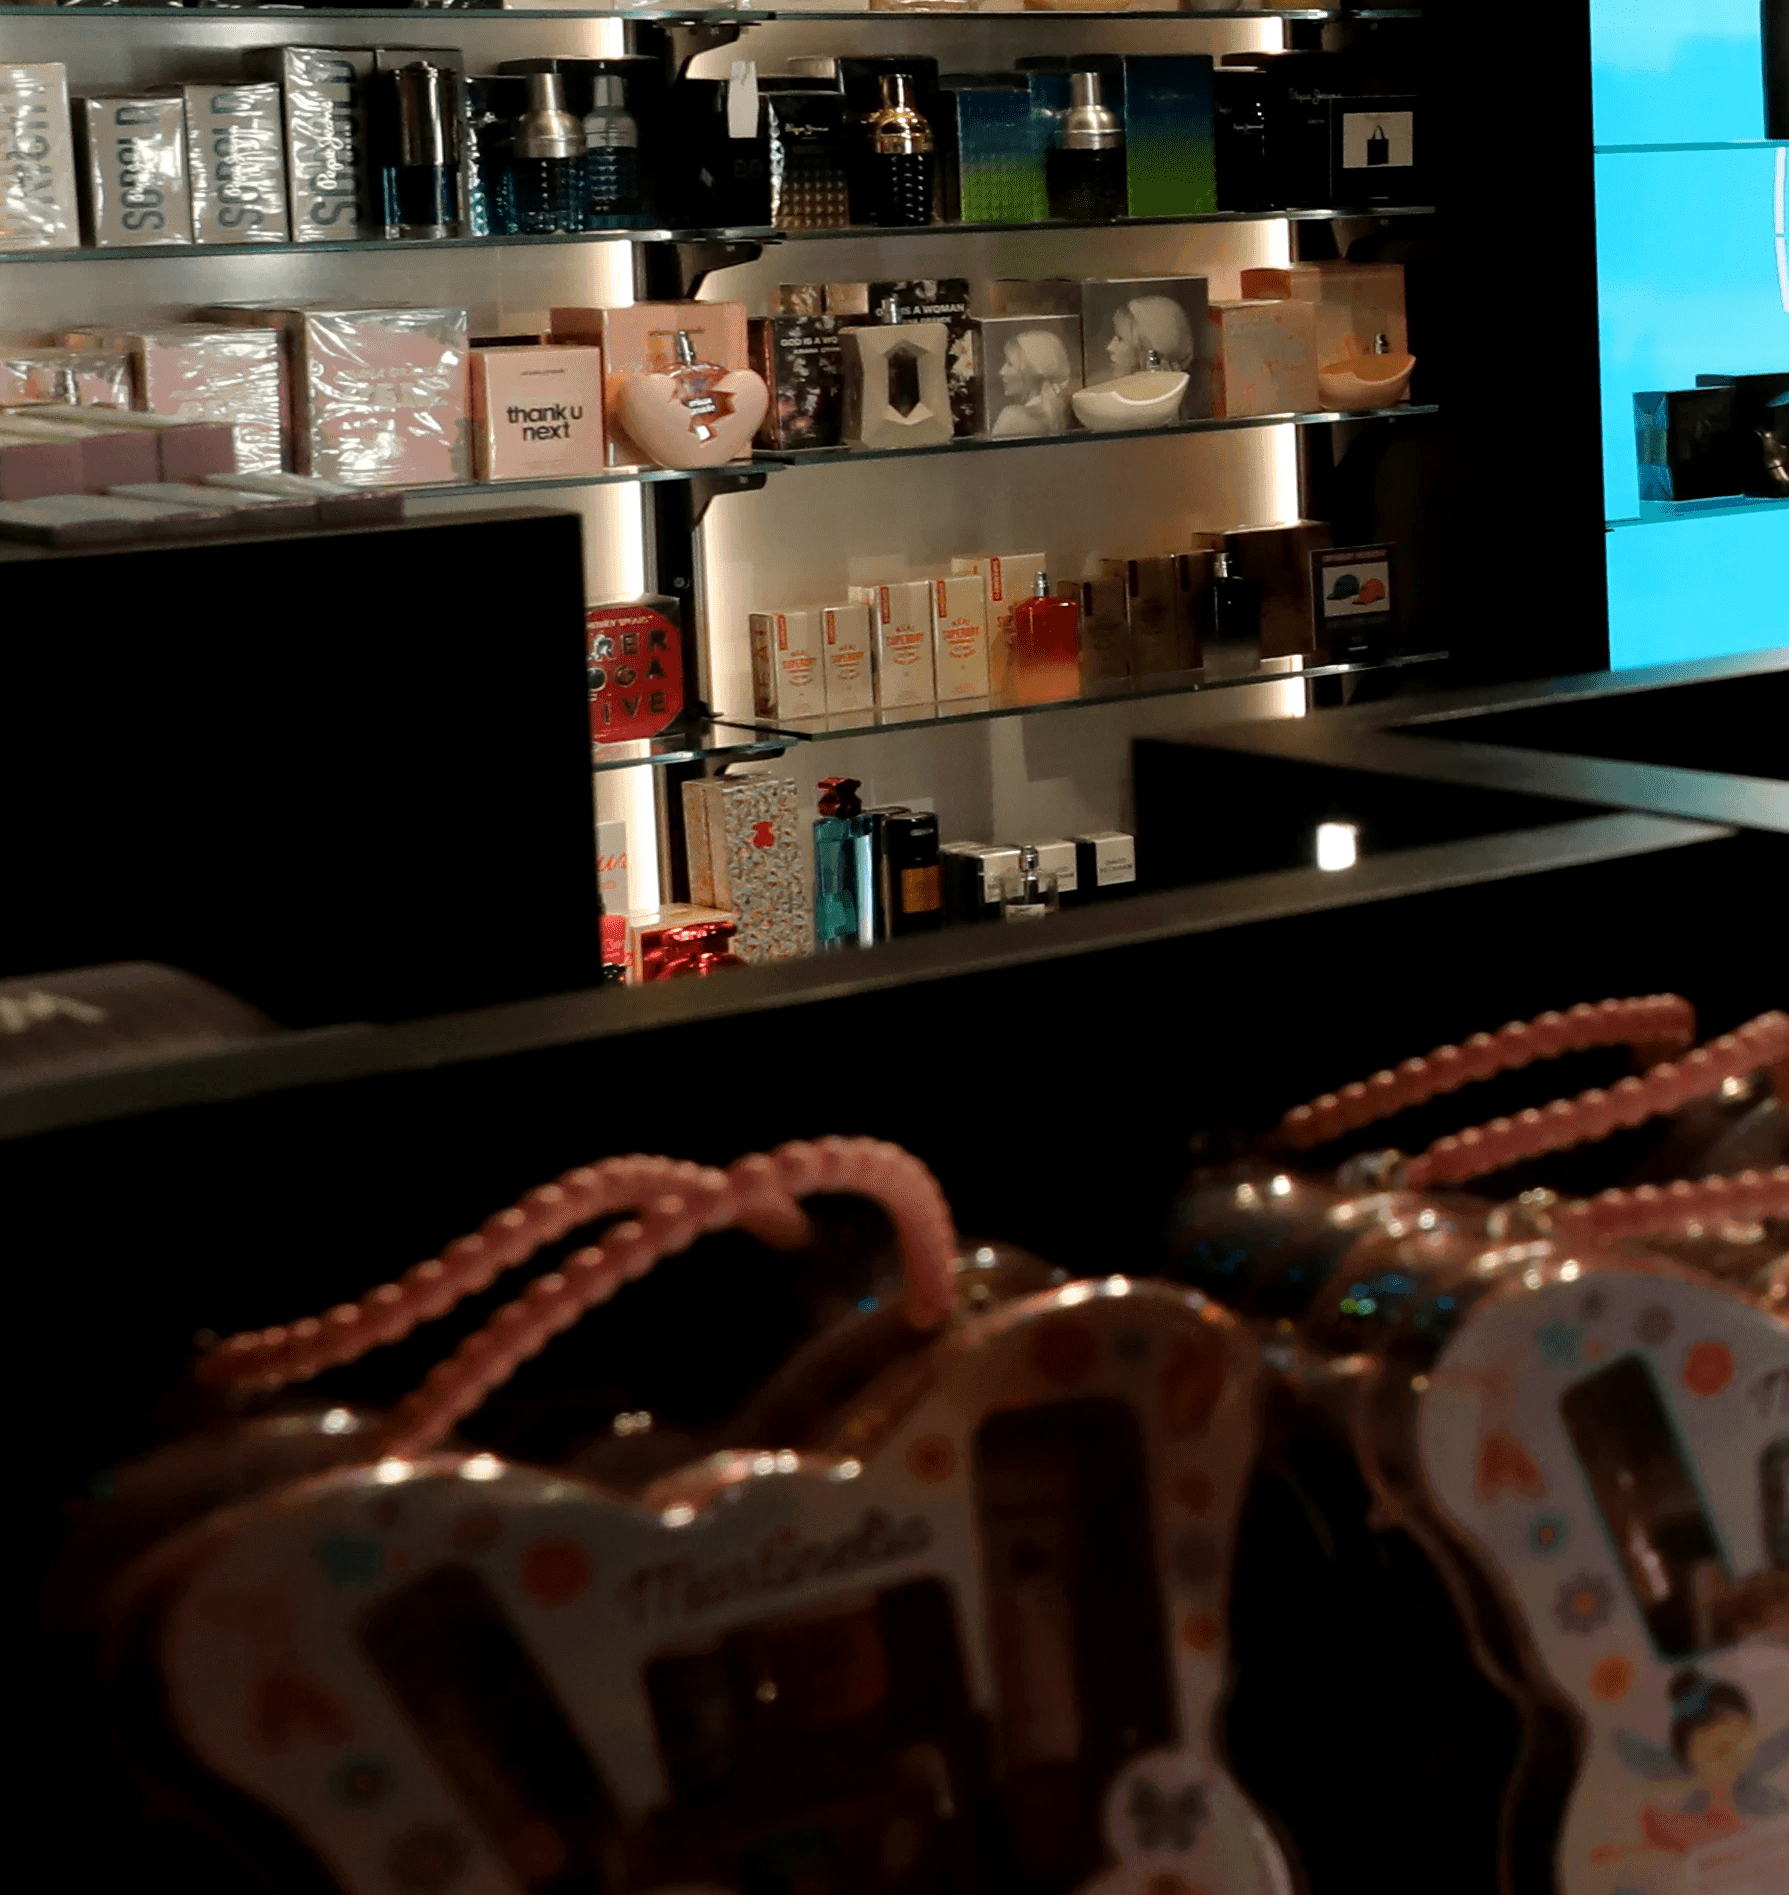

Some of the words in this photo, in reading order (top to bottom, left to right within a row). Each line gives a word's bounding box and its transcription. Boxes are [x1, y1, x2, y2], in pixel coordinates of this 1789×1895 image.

[923, 303, 966, 314] WOMAN
[507, 403, 568, 424] thank
[570, 404, 583, 419] u
[523, 421, 571, 442] next
